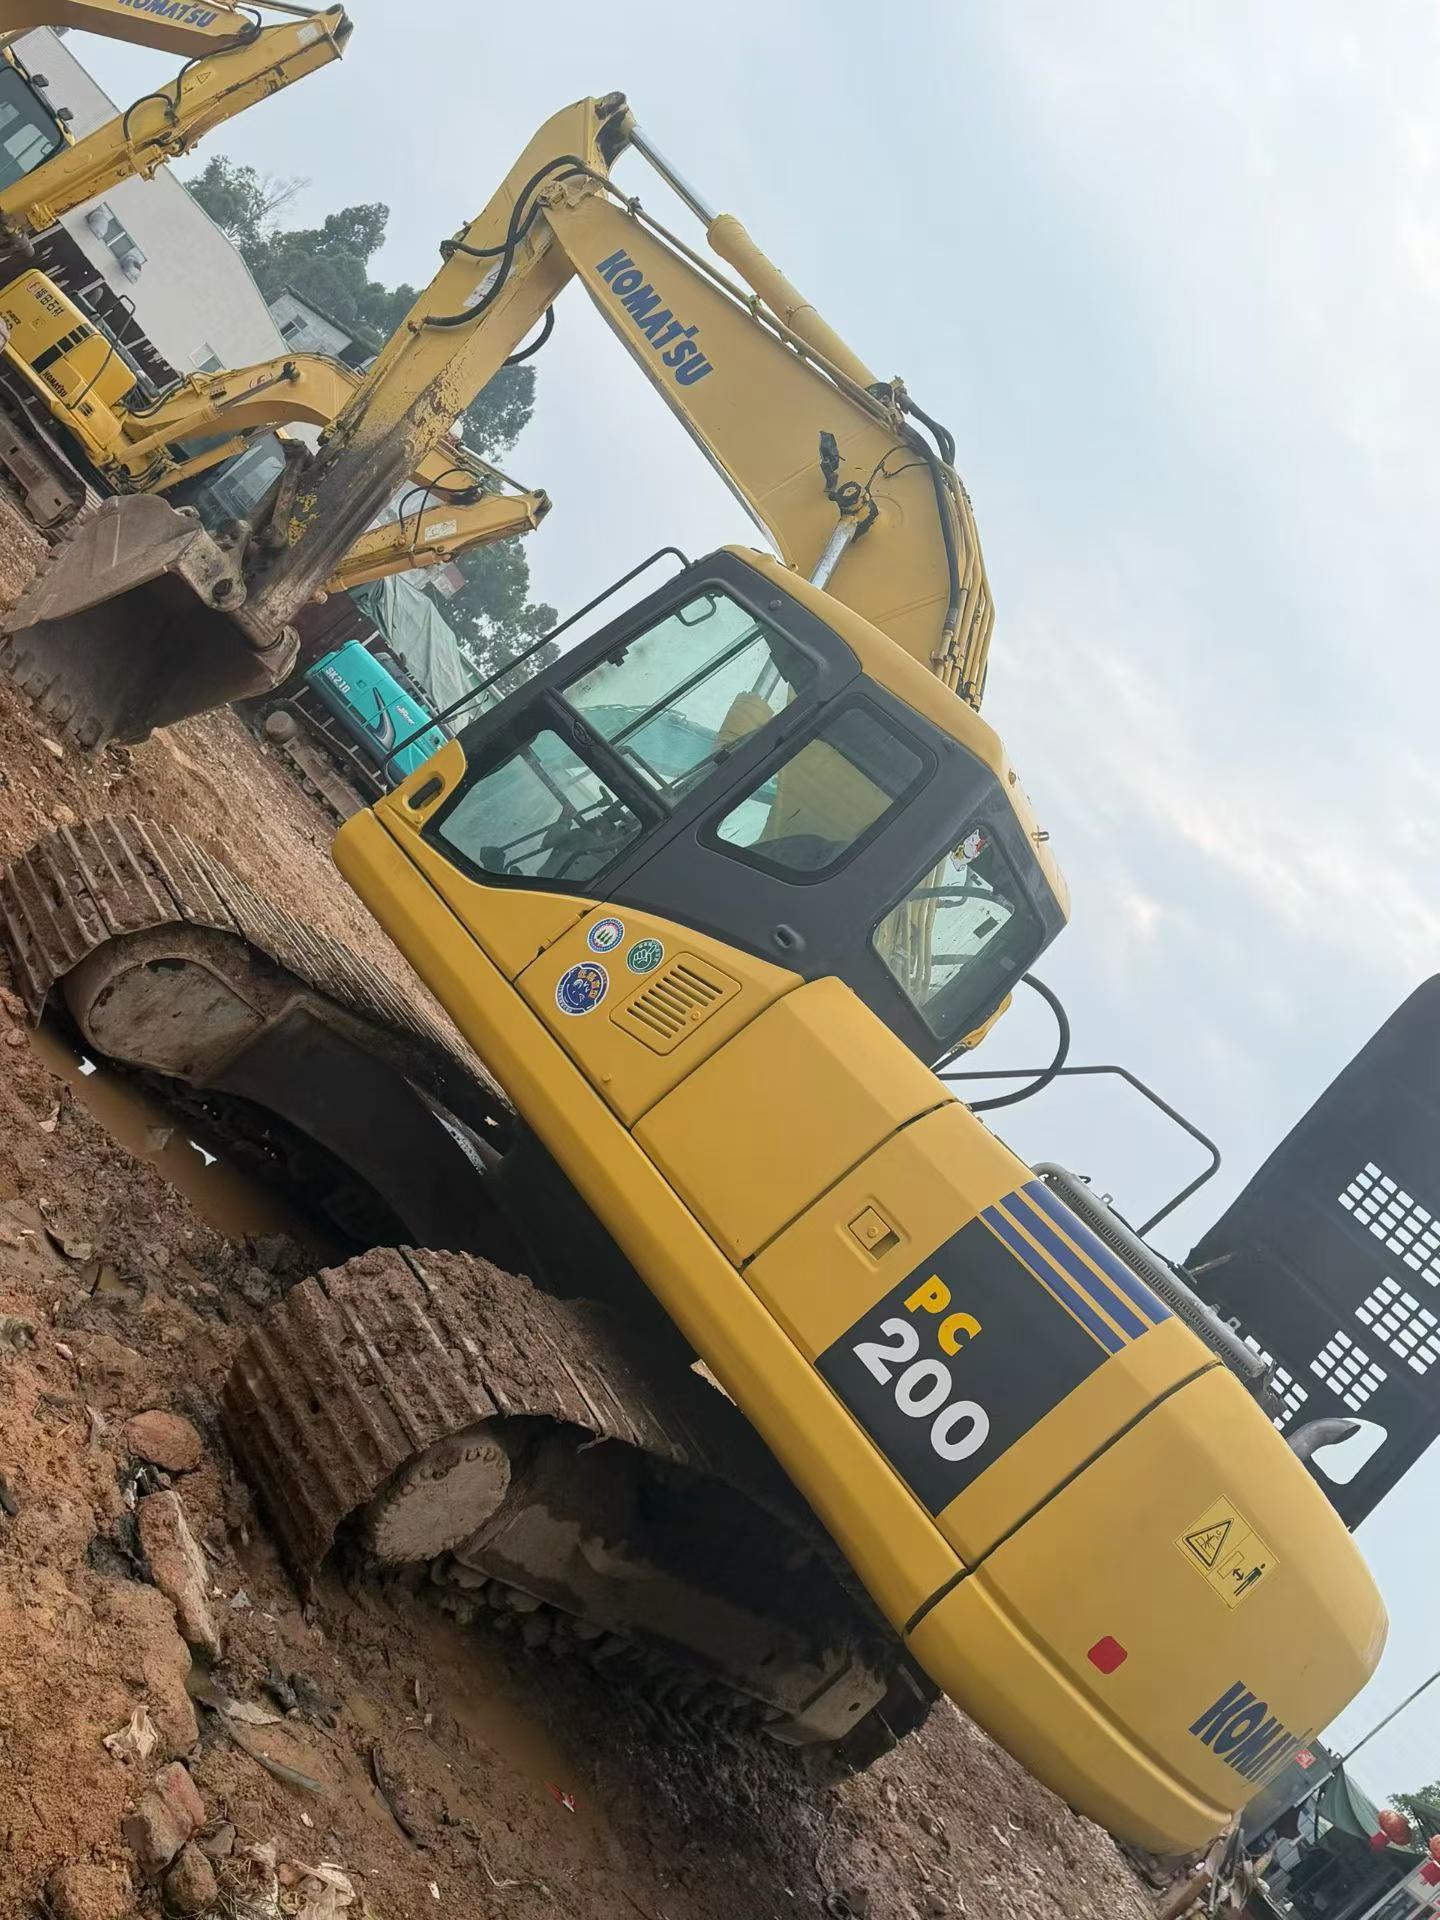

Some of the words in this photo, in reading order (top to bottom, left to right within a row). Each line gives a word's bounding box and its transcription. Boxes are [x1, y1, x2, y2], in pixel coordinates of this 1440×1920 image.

[595, 249, 714, 386] KOMATSU
[43, 371, 67, 398] KOMATSU
[325, 667, 351, 695] SK210
[904, 1274, 982, 1356] PC
[852, 1318, 990, 1461] 200
